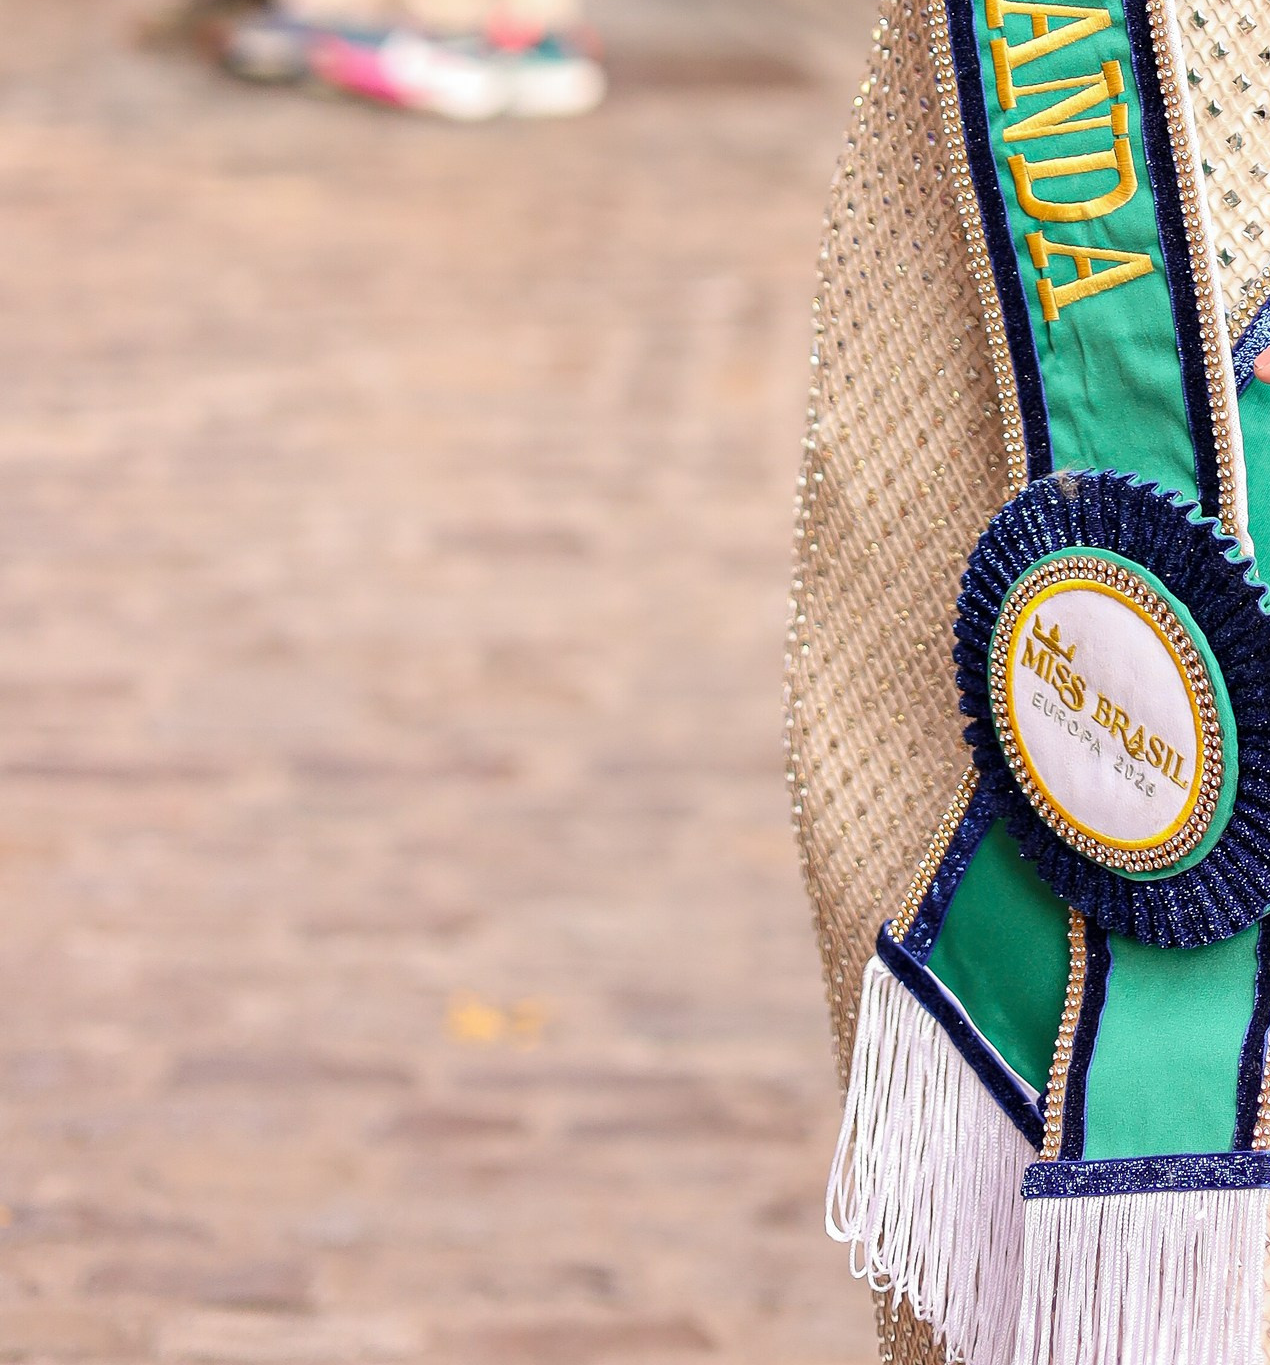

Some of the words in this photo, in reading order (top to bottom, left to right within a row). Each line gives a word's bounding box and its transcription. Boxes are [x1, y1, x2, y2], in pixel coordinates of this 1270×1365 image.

[1020, 636, 1088, 713] MISS
[1090, 692, 1190, 791] BRASIL
[1031, 691, 1102, 758] EUROPA
